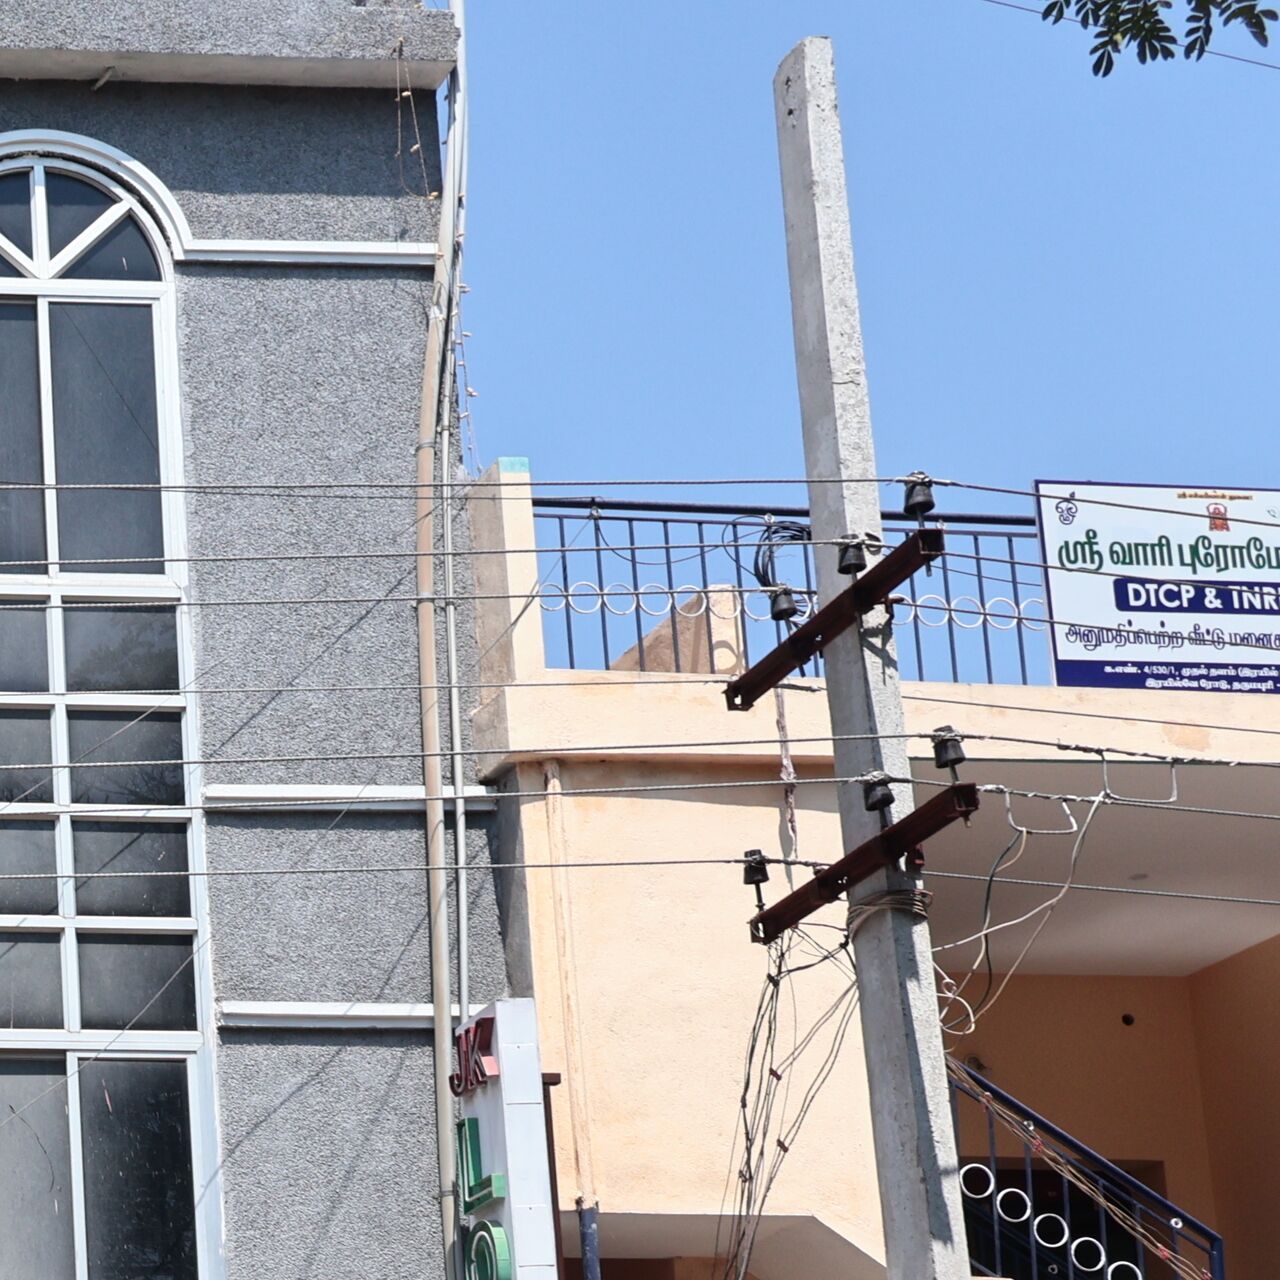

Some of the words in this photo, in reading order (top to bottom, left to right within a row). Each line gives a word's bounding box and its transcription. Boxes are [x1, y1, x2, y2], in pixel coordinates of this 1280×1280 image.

[1127, 583, 1195, 608] DTCP
[1204, 588, 1223, 609] &
[1230, 584, 1280, 610] TNR
